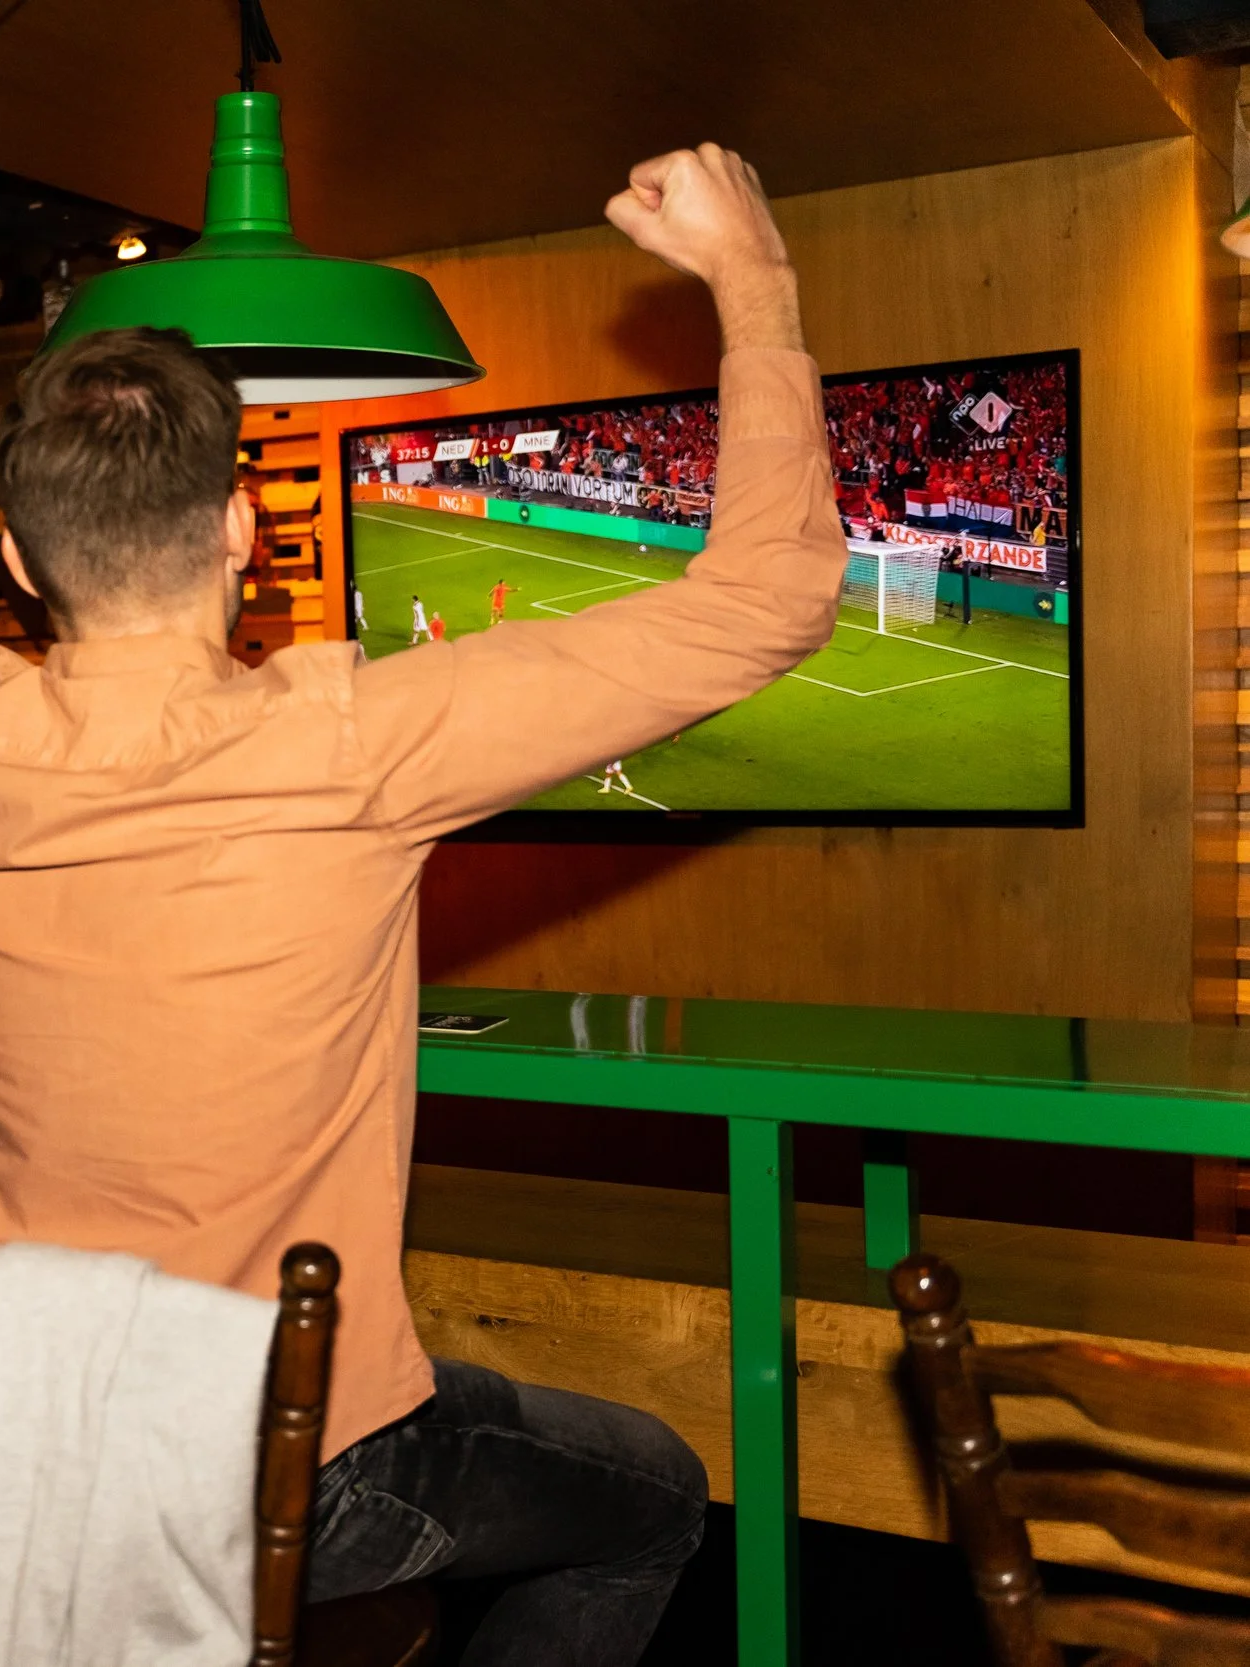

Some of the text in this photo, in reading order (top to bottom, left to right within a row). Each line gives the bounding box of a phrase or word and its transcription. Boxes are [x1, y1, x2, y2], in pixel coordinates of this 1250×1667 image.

[952, 397, 975, 421] npo
[396, 447, 430, 461] 37:15
[441, 444, 465, 455] NED
[523, 435, 551, 447] MNE
[974, 436, 1006, 451] LIVE
[382, 487, 408, 503] ING
[439, 496, 460, 512] ING
